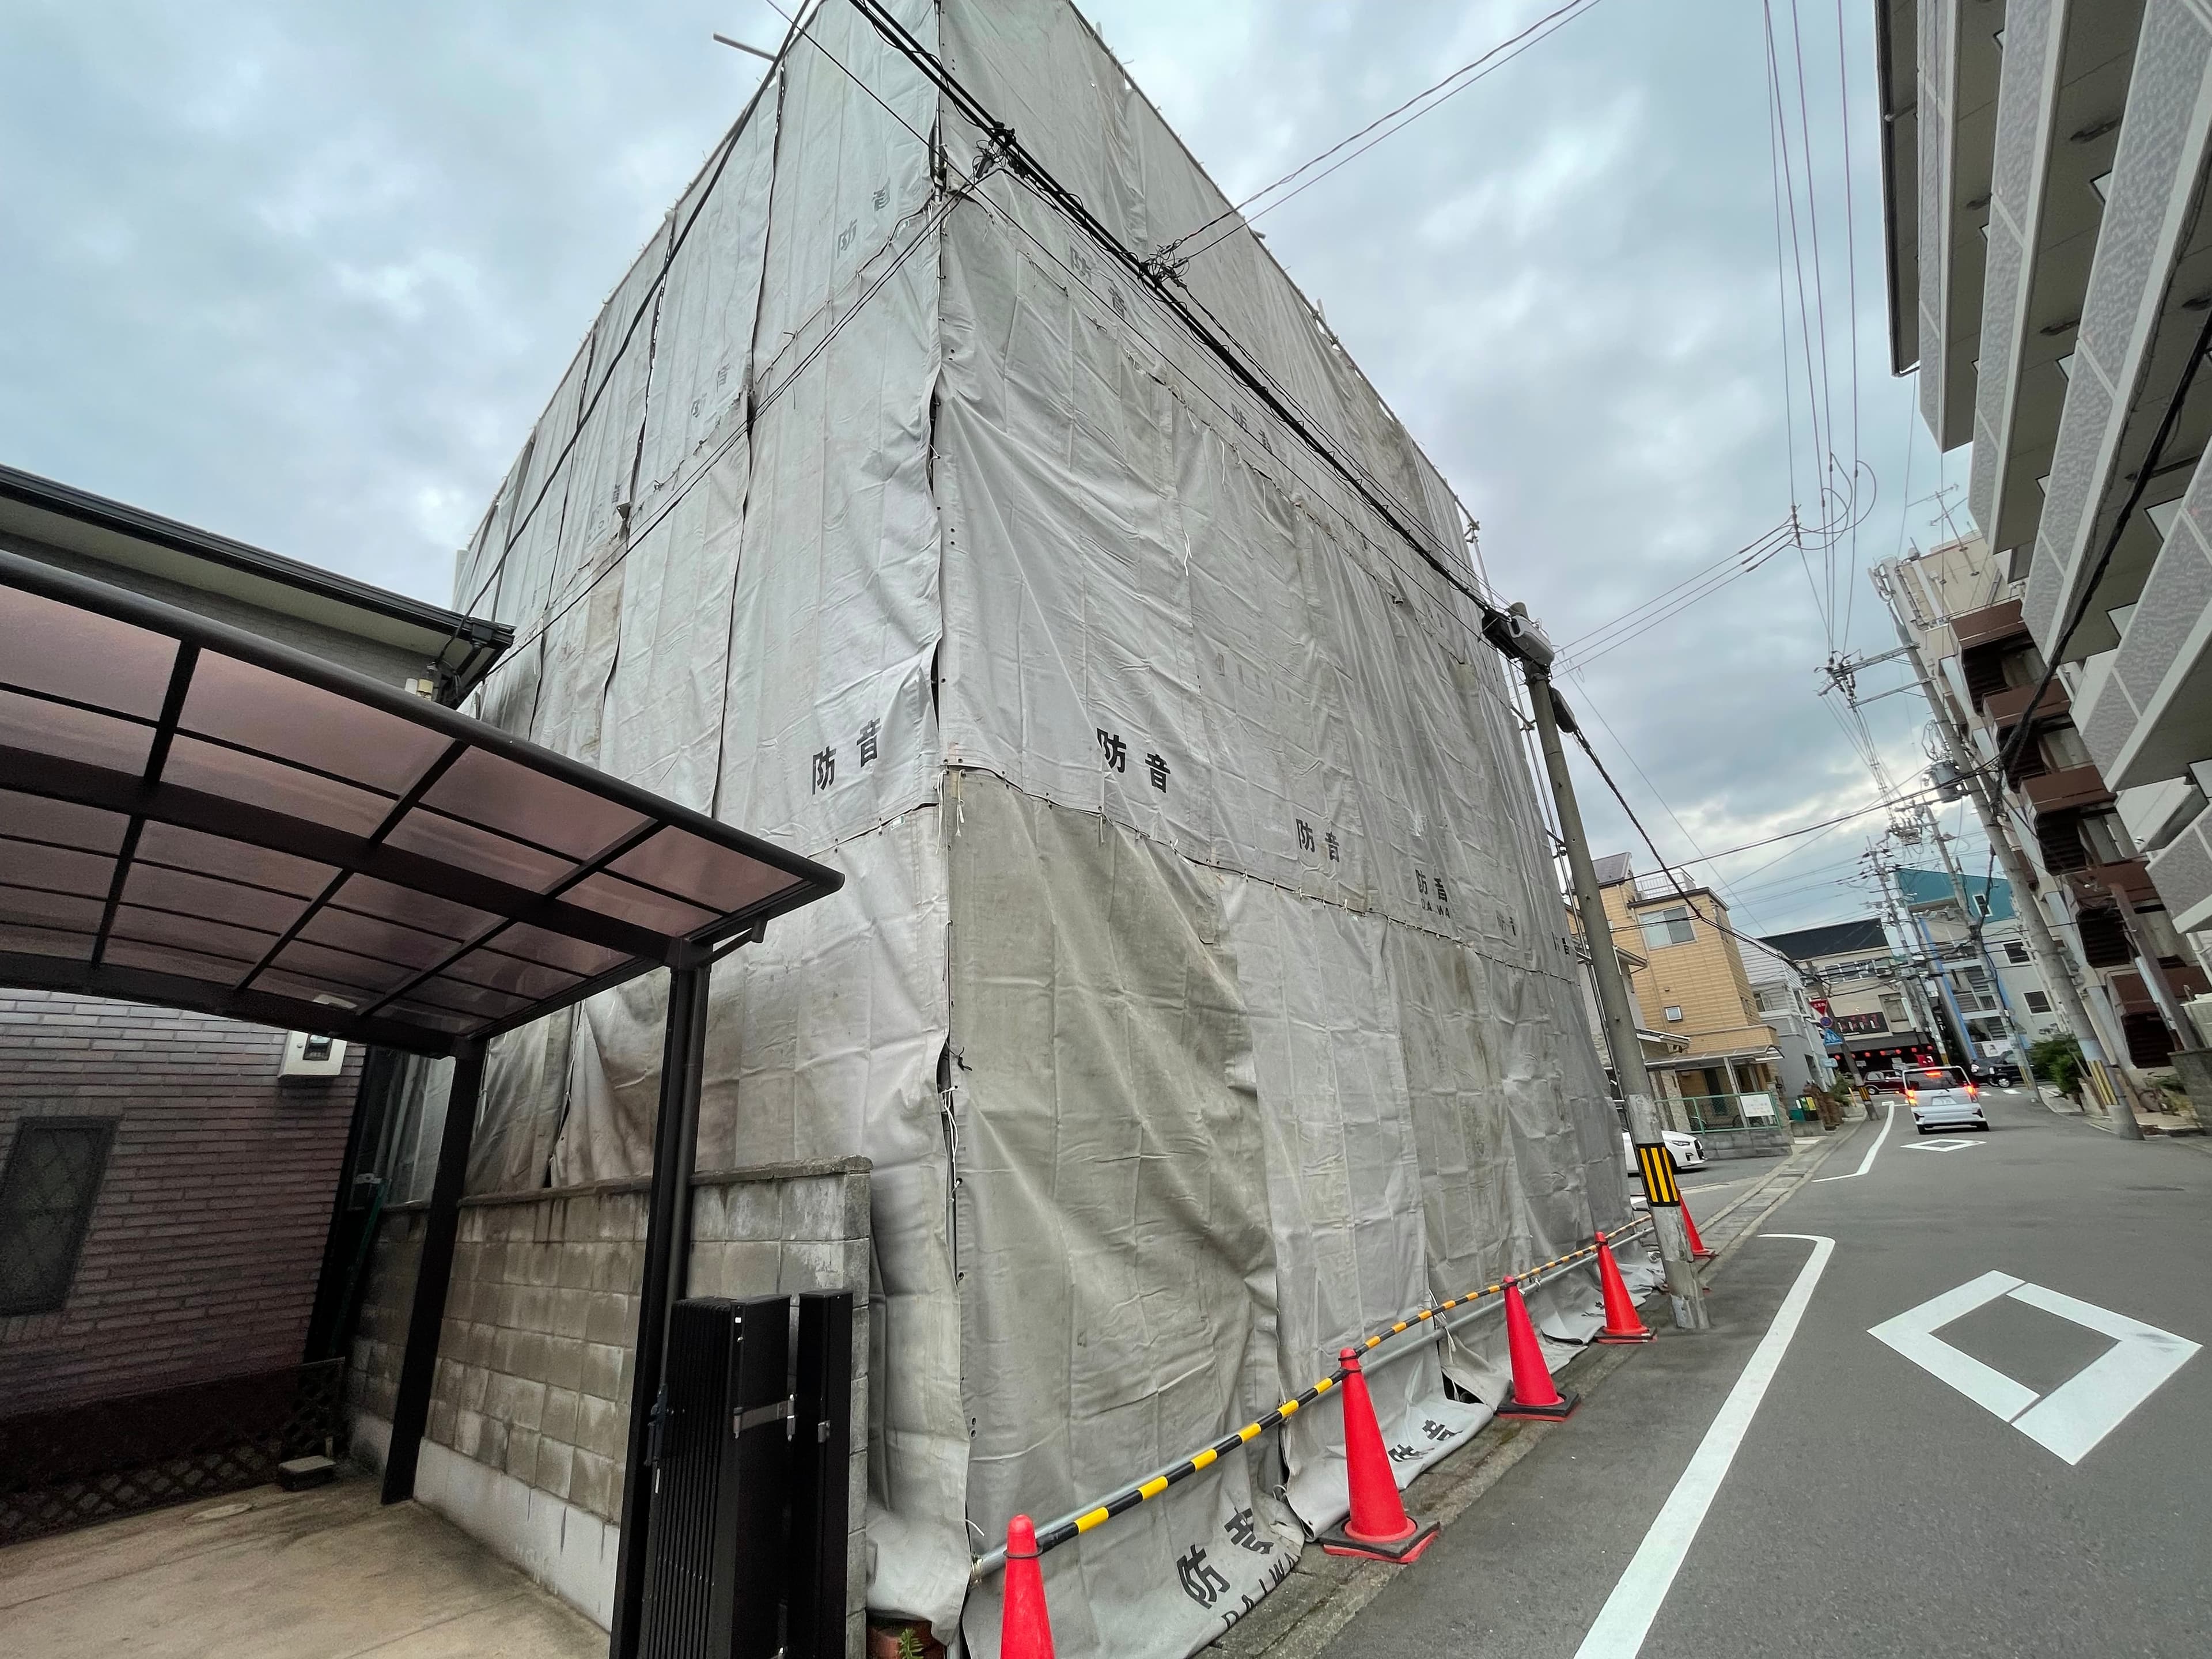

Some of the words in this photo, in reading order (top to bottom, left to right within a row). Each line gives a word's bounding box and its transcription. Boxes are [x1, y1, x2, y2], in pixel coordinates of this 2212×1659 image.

[811, 717, 883, 795] 防音
[1096, 727, 1171, 794] 防音
[1295, 818, 1340, 863] 防音
[1415, 869, 1448, 903] 防音
[1176, 1507, 1274, 1609] 防音
